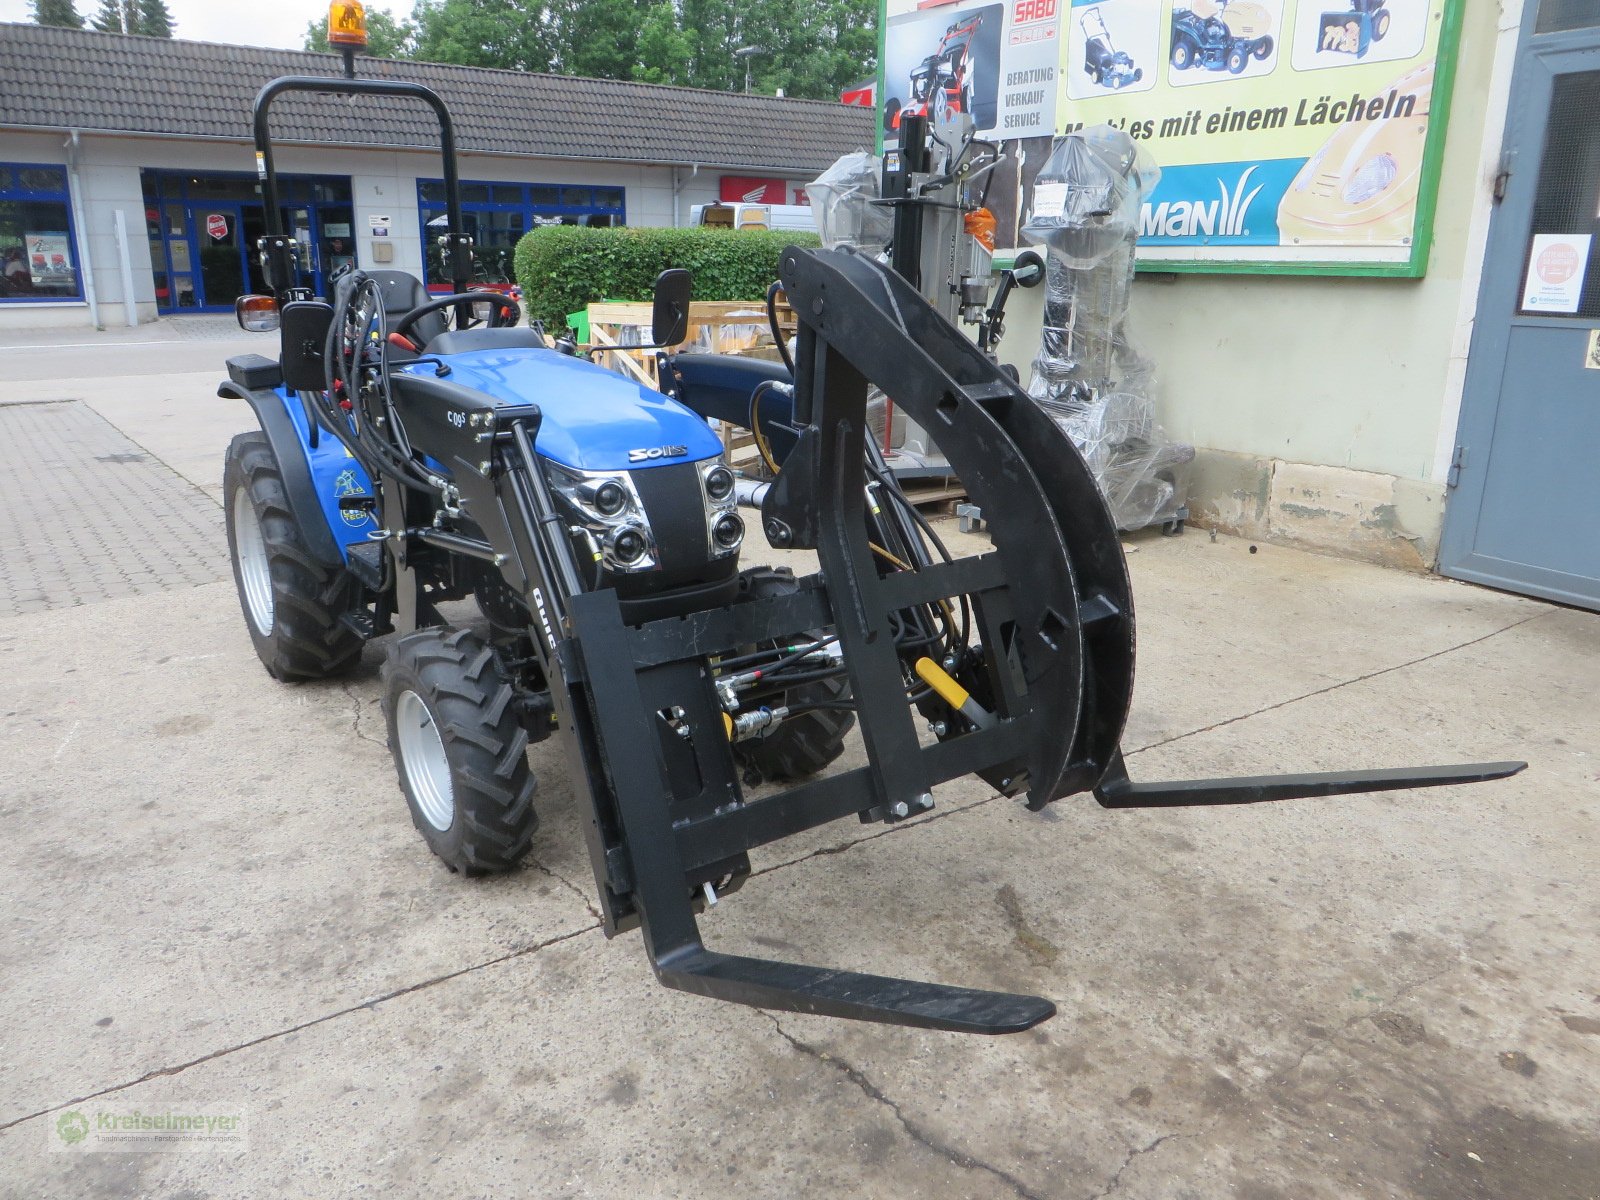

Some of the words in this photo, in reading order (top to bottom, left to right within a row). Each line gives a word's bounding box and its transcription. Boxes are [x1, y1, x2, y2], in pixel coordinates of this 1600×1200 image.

[1014, 0, 1056, 23] SABO
[1006, 67, 1054, 86] BERATUNG
[1005, 90, 1045, 107] VERKAUF
[1004, 112, 1041, 128] SERVICE
[1129, 120, 1154, 140] es
[1159, 110, 1202, 139] mit
[1205, 105, 1289, 136] einem
[1295, 89, 1418, 125] Lächeln
